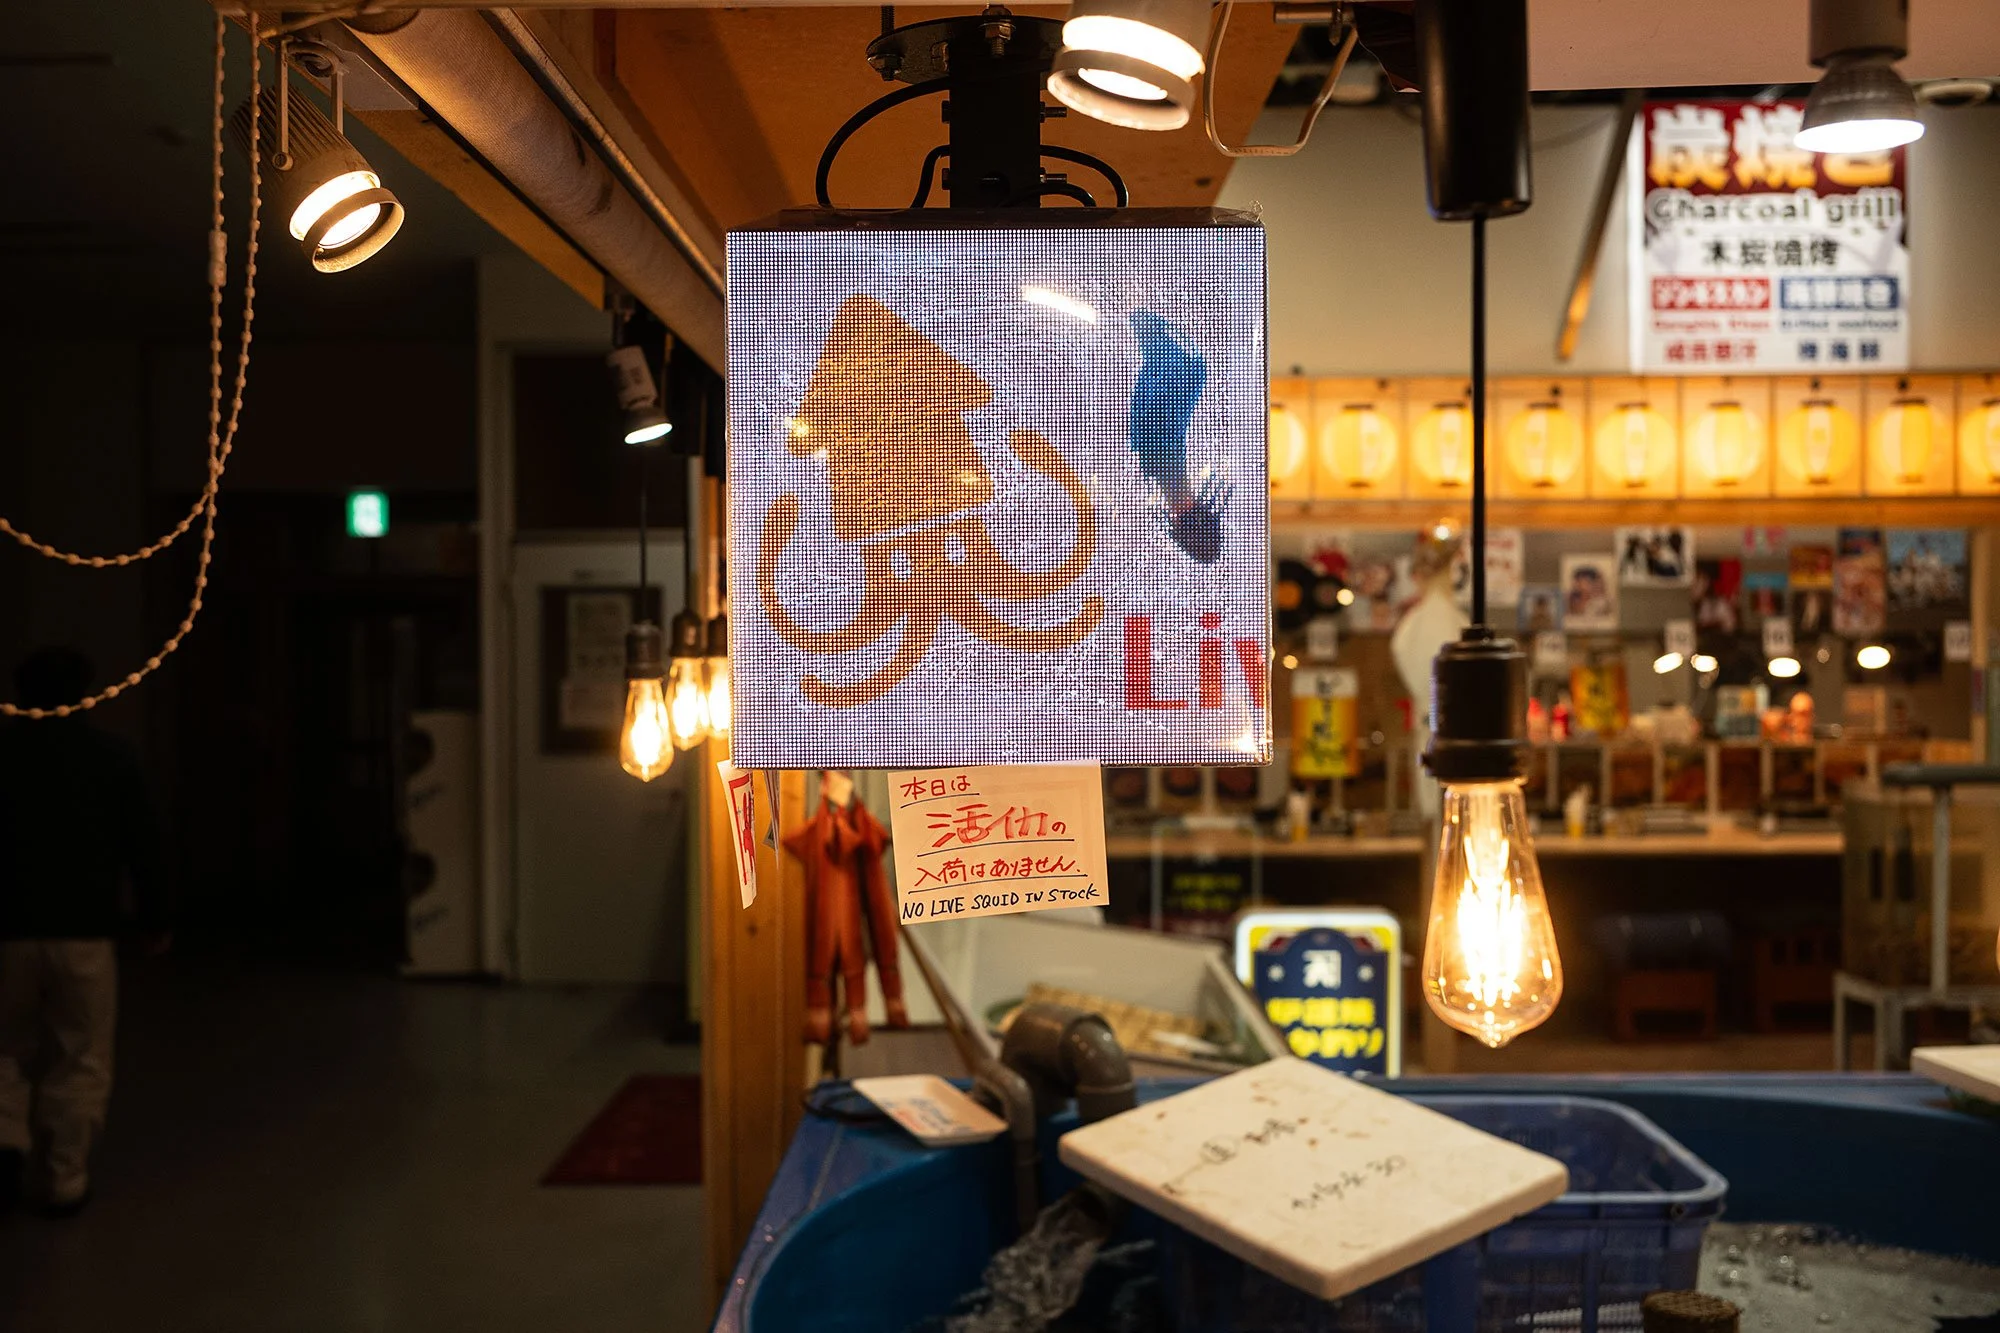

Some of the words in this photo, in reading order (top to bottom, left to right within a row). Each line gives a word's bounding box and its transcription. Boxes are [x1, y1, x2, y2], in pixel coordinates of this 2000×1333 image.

[1653, 196, 1811, 219] Charcoal
[1827, 196, 1897, 222] grill
[900, 775, 971, 800] 本日は
[902, 901, 924, 920] NO
[931, 896, 965, 915] LIVE
[971, 891, 1019, 910] SQUID
[1025, 891, 1043, 904] IN
